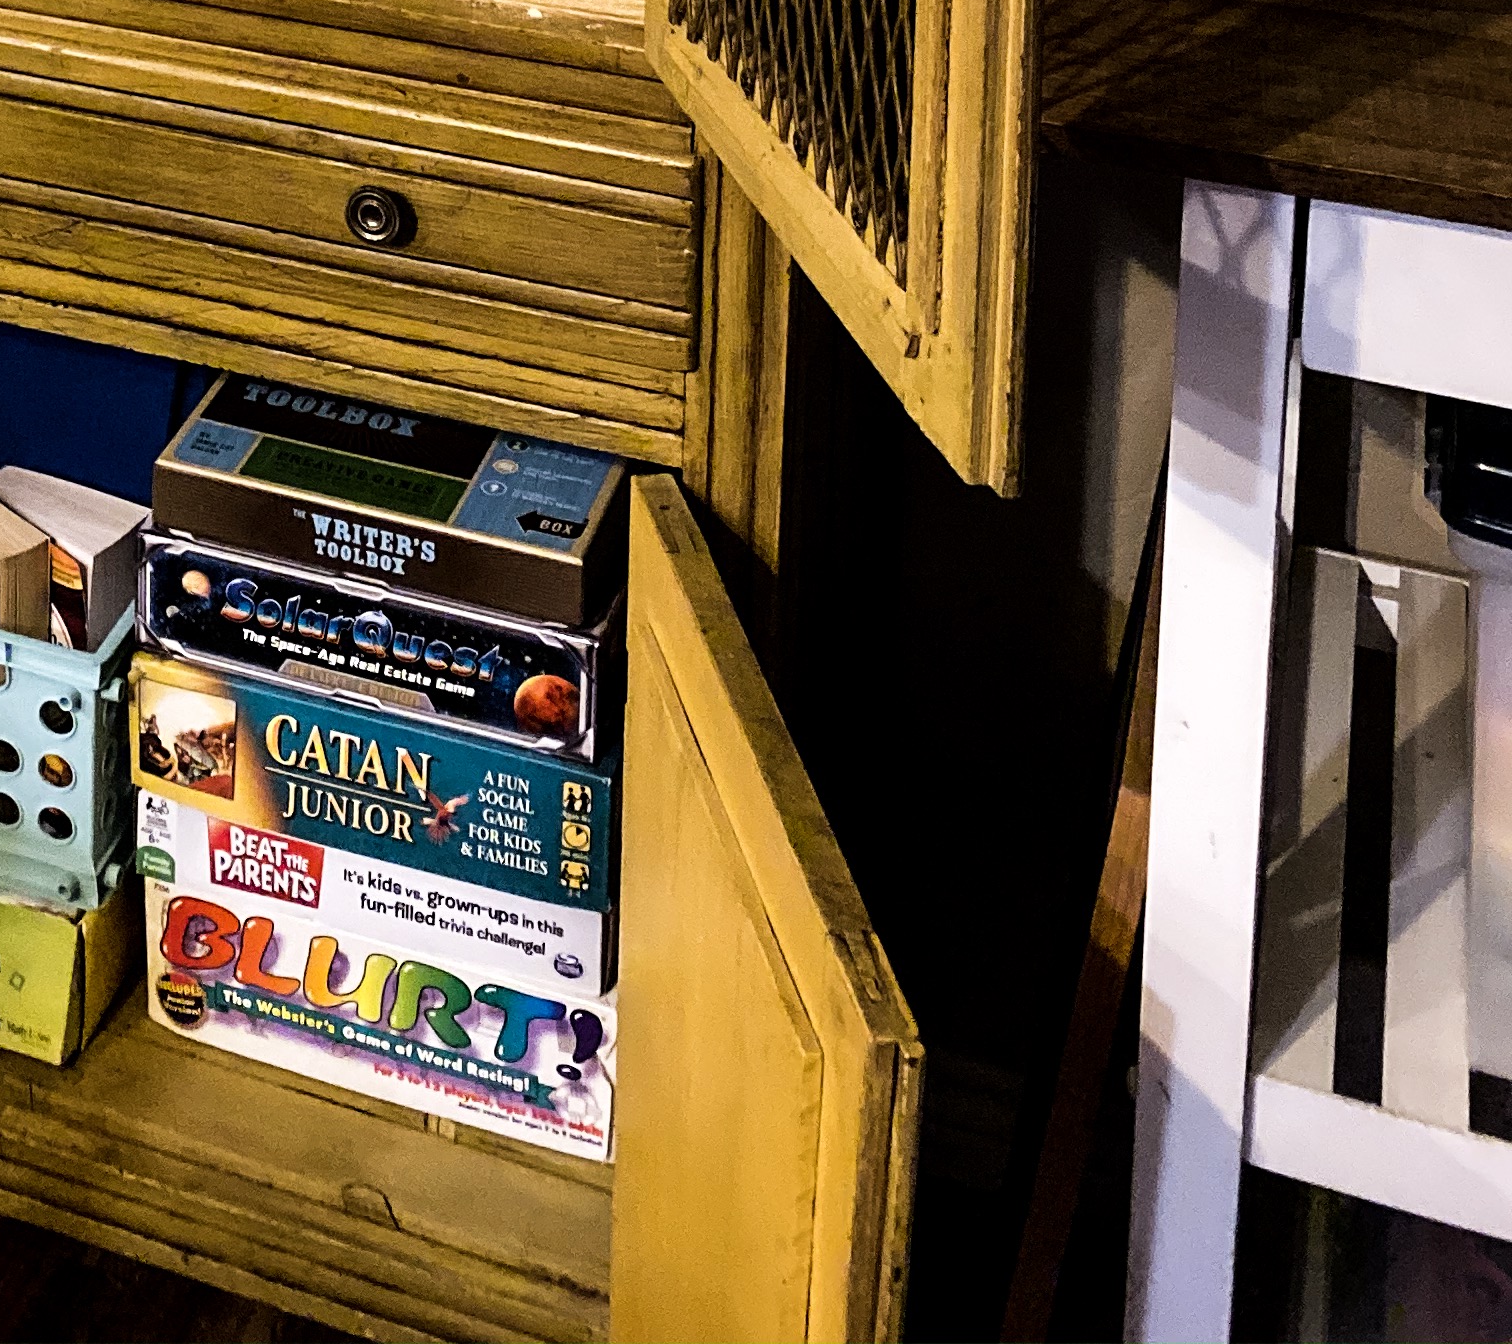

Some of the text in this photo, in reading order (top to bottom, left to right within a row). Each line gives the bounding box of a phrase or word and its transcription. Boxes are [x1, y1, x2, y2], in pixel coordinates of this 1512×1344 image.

[243, 382, 422, 438] TOOLBOX
[311, 513, 436, 563] WRITER'S
[539, 519, 574, 535] BOX
[314, 538, 406, 576] TOOLBOX
[220, 577, 504, 682] SolarQuest
[242, 627, 476, 698] The Space-Age Real Estate Game
[265, 714, 434, 802] CATAN
[477, 787, 535, 816] SOCIAL
[483, 770, 530, 795] A FUN
[282, 780, 415, 844] JUNIOR
[482, 808, 529, 833] GAME
[229, 825, 289, 867] BEAT
[460, 842, 473, 858] &
[477, 844, 549, 876] FAMILIES
[468, 822, 500, 845] FOR
[503, 832, 543, 855] KIDS
[213, 848, 318, 904] PARENTS
[284, 853, 310, 874] THE
[343, 868, 565, 938] It's kids vs. grown-ups in this
[360, 893, 436, 927] fun-filled
[439, 917, 474, 938] trivia
[159, 895, 605, 1082] BLURT!
[222, 989, 531, 1092] The Webster's Game of Word Racing!
